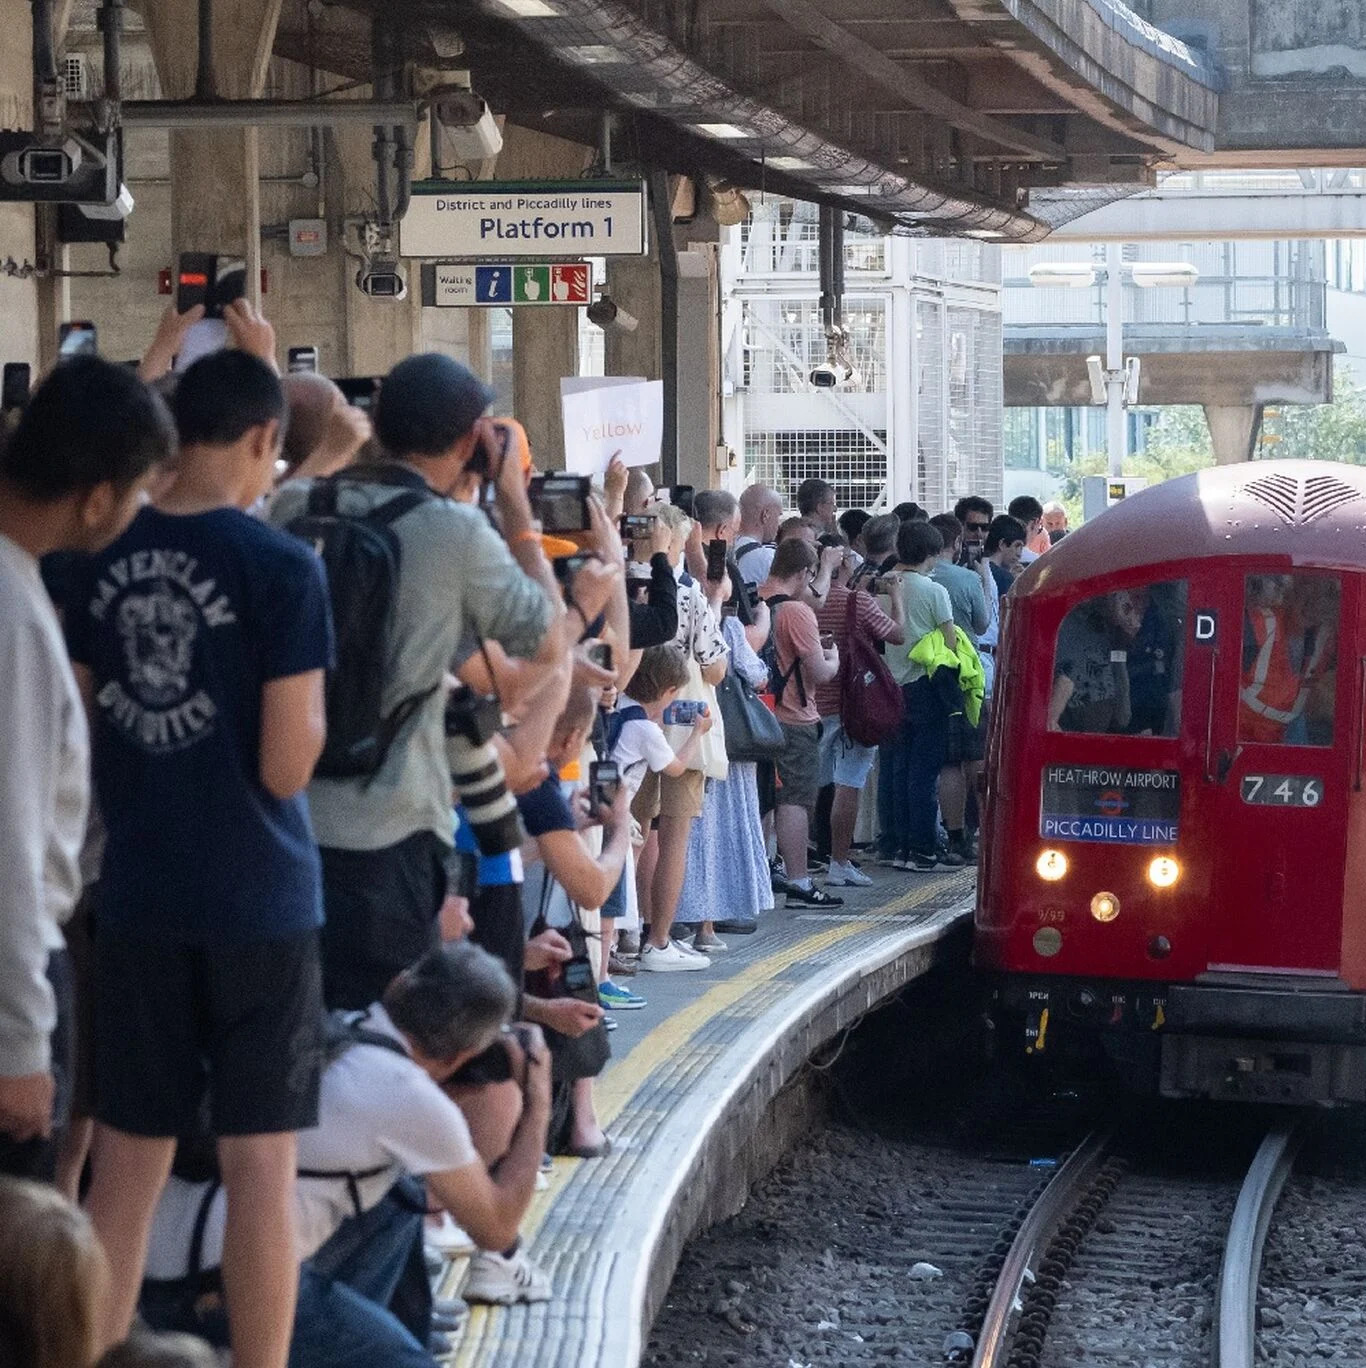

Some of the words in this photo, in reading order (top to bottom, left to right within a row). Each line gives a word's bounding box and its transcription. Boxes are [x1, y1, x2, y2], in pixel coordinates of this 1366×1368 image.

[436, 198, 485, 211] District
[489, 198, 513, 210] and
[517, 198, 577, 212] Piccadilly
[581, 197, 612, 209] lines
[480, 217, 594, 239] Platform
[603, 216, 613, 238] 1
[439, 275, 473, 285] Waiting
[582, 422, 643, 441] Yellow
[1195, 615, 1215, 639] D
[1048, 768, 1122, 786] HEATHROW
[1124, 772, 1178, 789] AIRPORT
[1244, 776, 1319, 806] 746
[1044, 819, 1139, 838] PICCADILLY
[1142, 825, 1178, 841] LINE
